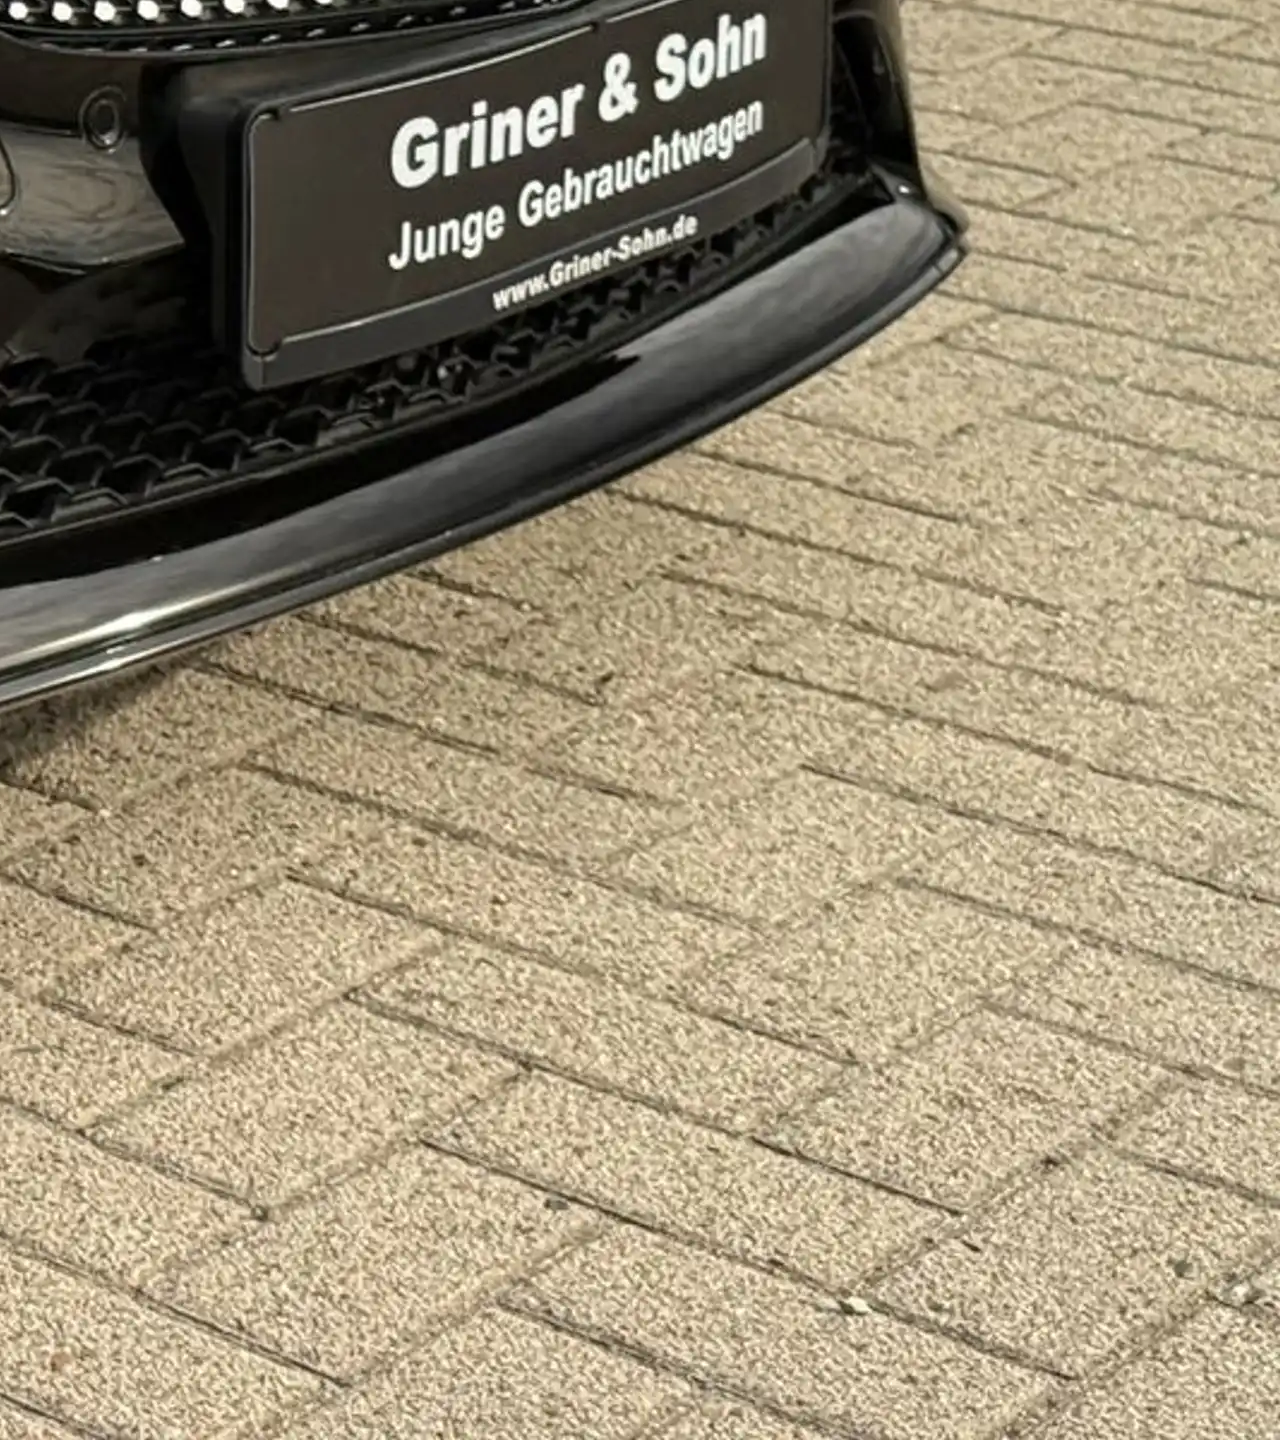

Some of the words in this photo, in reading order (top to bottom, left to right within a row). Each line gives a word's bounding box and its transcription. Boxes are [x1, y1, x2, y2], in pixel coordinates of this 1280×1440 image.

[388, 204, 506, 270] Junge
[518, 100, 764, 227] Gebrauchtwagen
[391, 83, 585, 188] Griner
[598, 52, 639, 122] &
[653, 13, 766, 102] Sohn
[492, 214, 699, 311] www.Griner-Sohn.de
